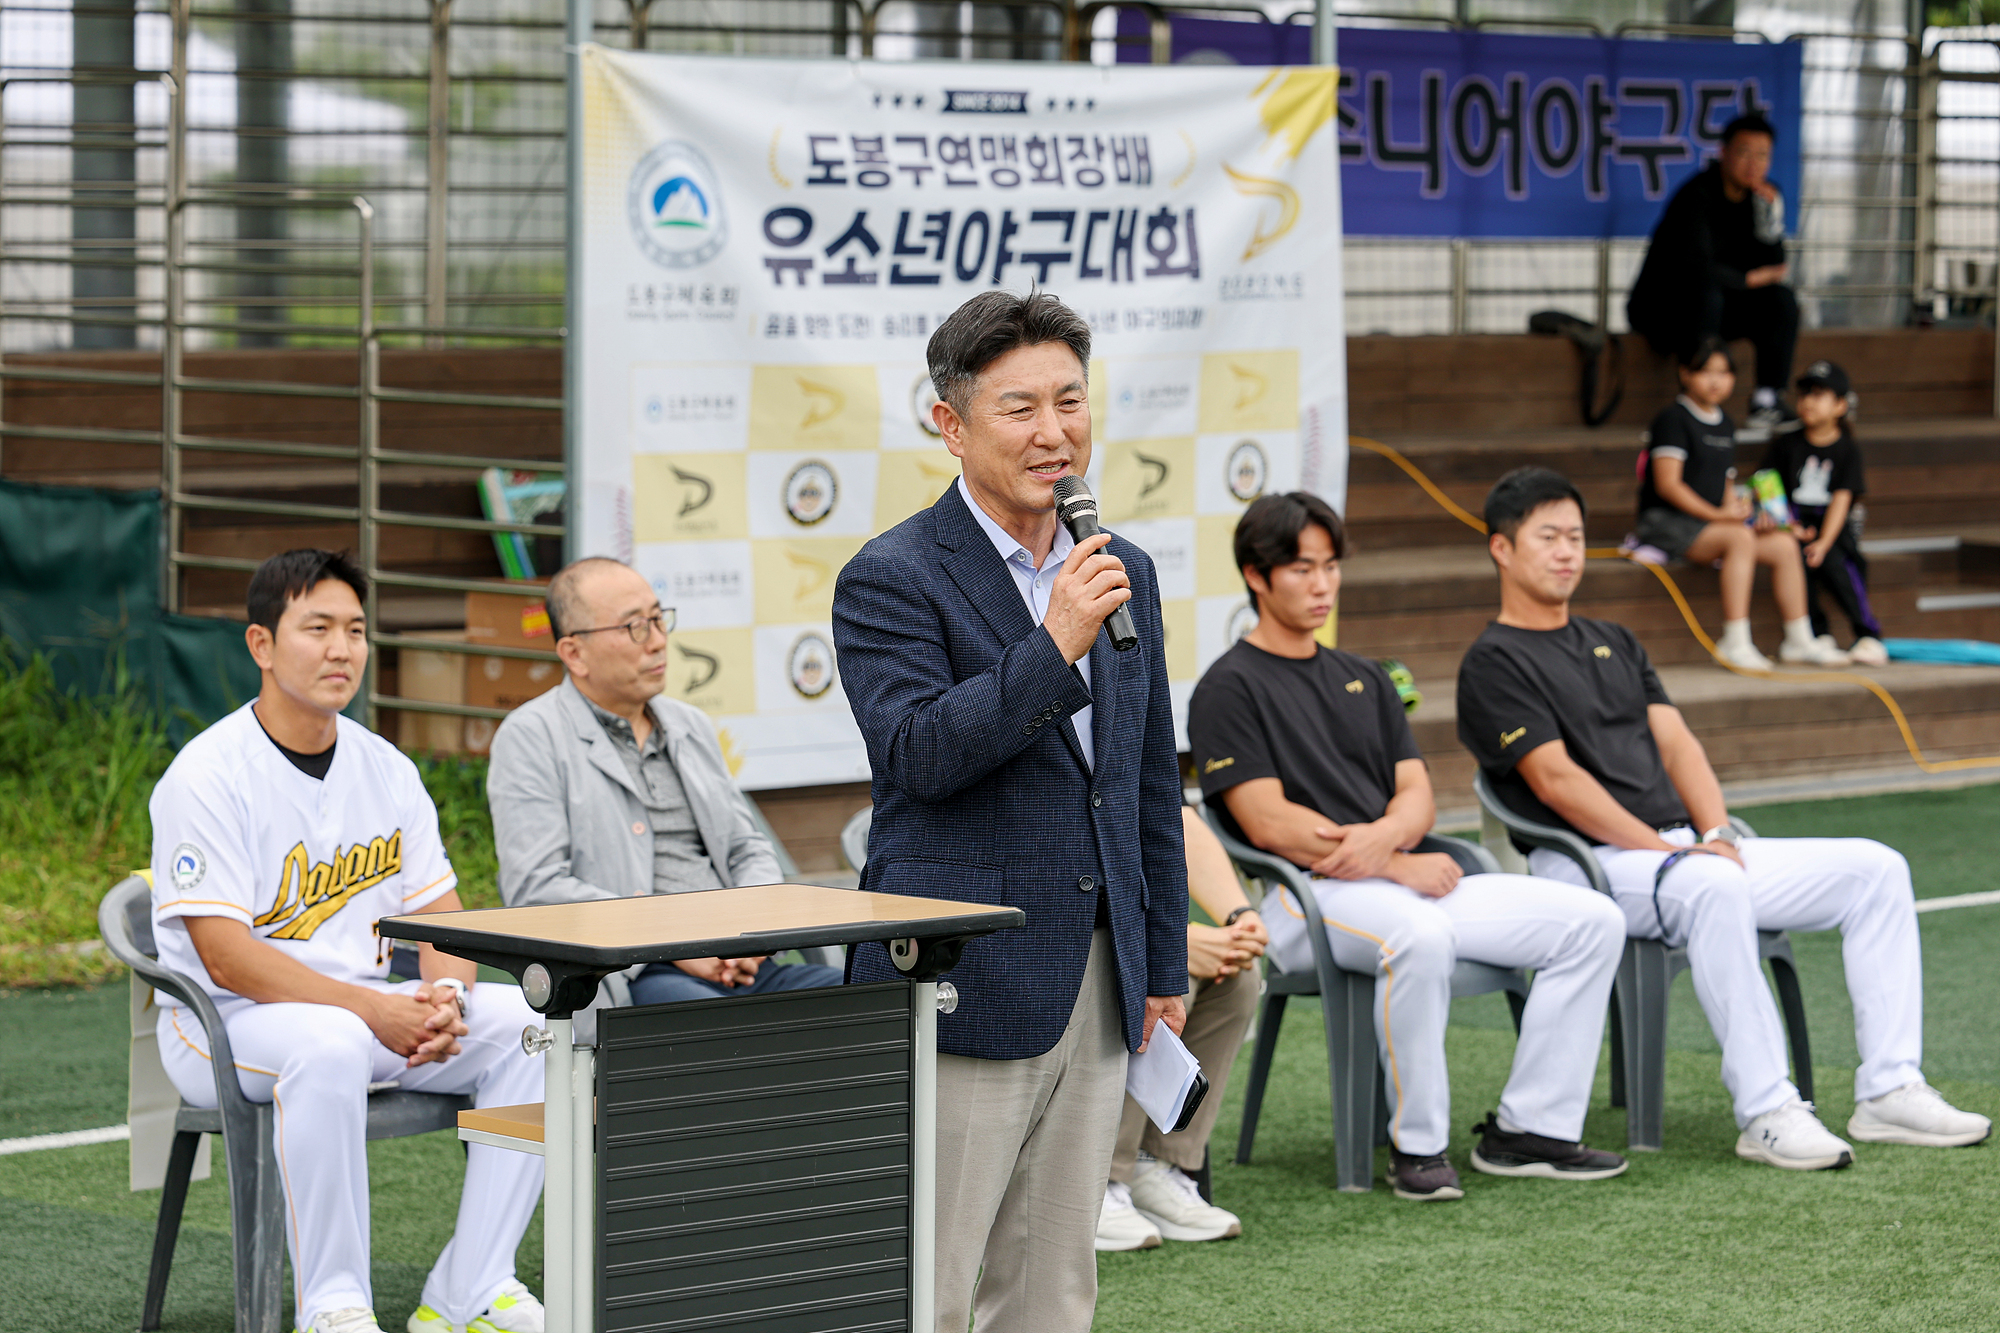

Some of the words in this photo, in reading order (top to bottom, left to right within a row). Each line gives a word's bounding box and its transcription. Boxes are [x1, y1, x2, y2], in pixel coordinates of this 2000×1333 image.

[807, 134, 1153, 188] 도봉구연맹회장배
[762, 206, 1201, 286] 유소년야구대회
[253, 828, 402, 930] Dobong
